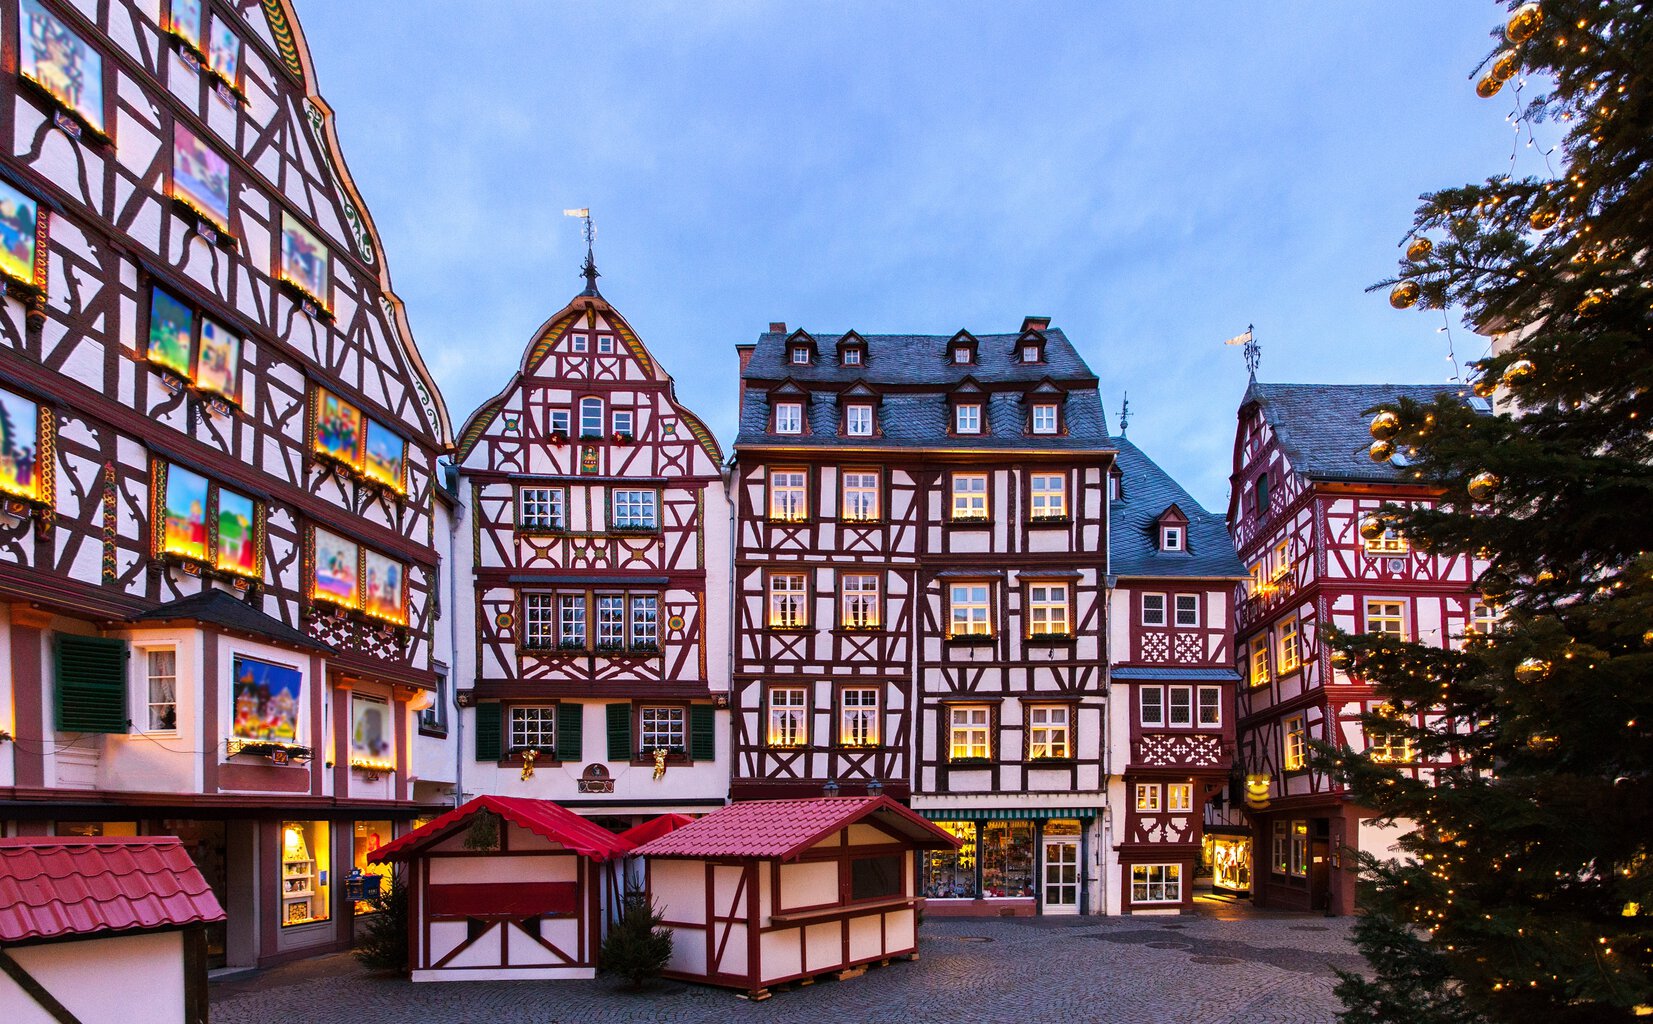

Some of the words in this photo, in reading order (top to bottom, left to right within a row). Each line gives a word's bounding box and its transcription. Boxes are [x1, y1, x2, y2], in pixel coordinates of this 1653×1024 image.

[11, 502, 24, 513] 9
[184, 562, 199, 574] 21
[234, 578, 248, 590] 22
[274, 751, 286, 763] 24
